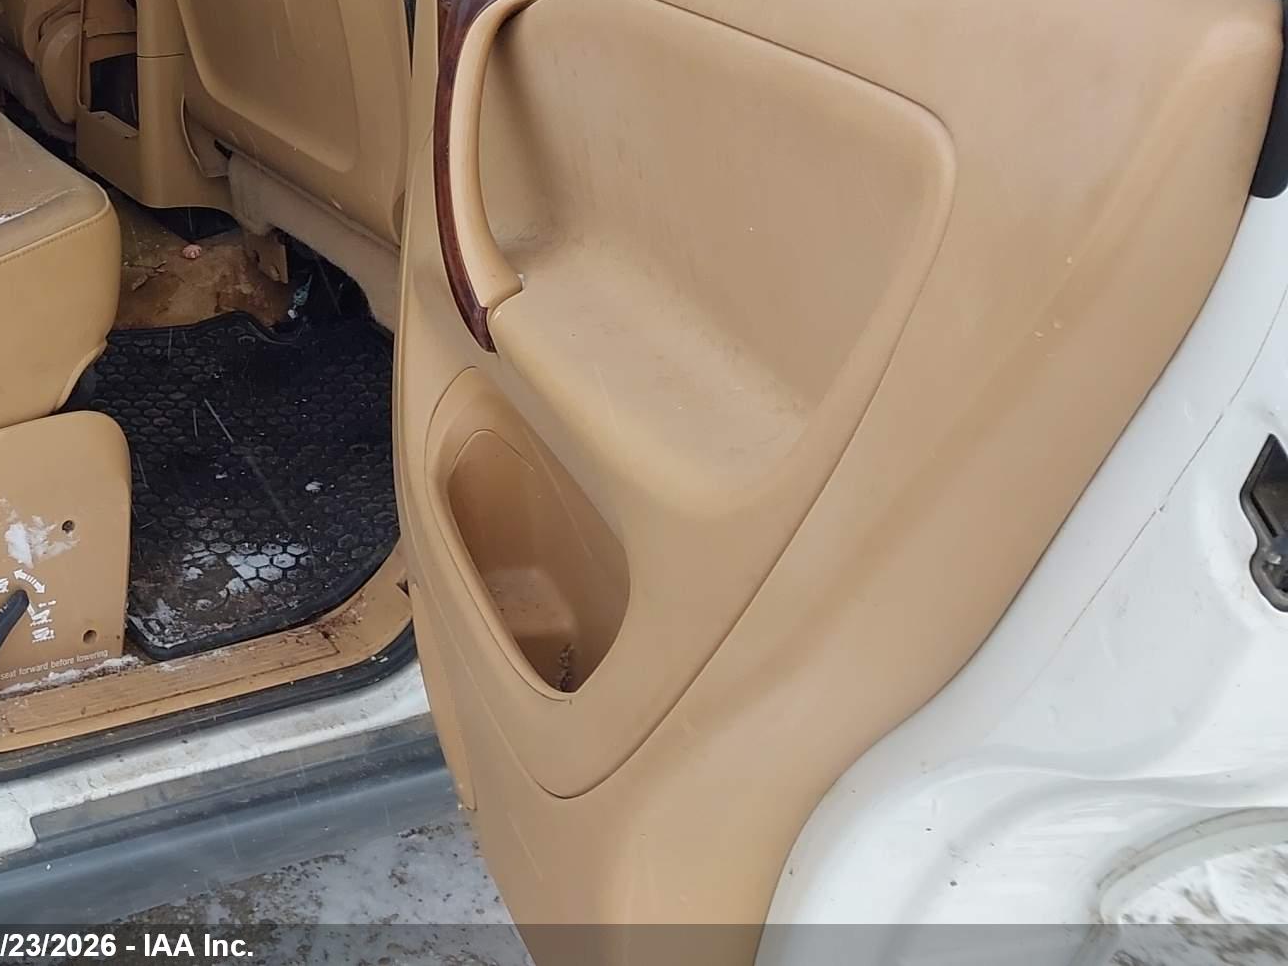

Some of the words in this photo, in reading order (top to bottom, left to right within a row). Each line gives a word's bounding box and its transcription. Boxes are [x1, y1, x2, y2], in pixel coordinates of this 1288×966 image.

[0, 669, 17, 681] seat
[19, 661, 49, 675] forward
[50, 657, 74, 669] before
[77, 649, 109, 664] lowering
